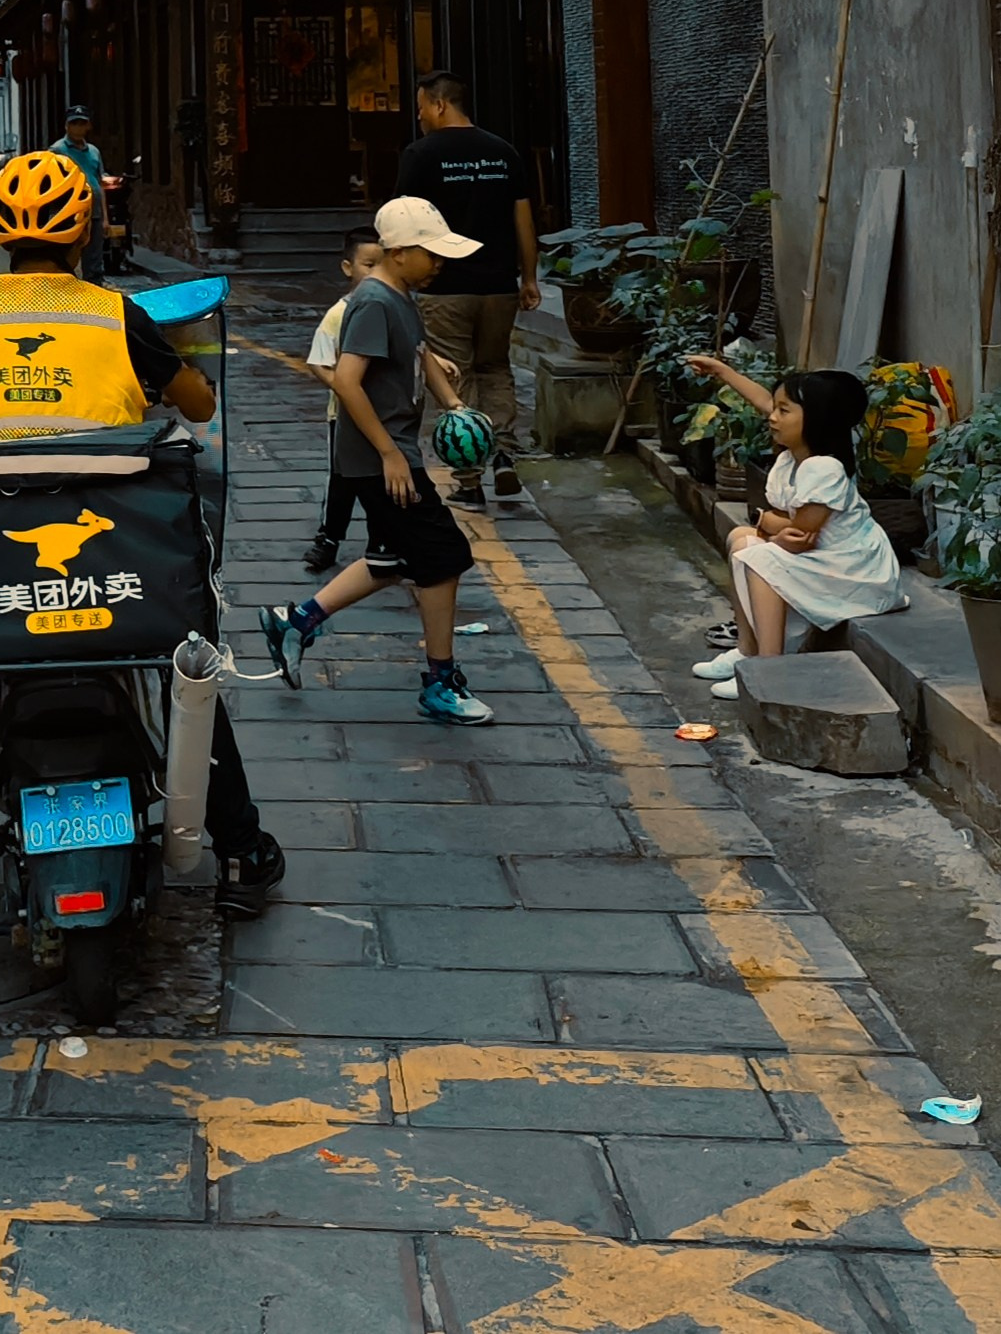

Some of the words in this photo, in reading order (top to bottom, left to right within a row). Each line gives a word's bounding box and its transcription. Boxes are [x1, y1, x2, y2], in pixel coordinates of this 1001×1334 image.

[35, 611, 103, 631] 美团专送
[43, 792, 109, 815] 张家界
[30, 812, 129, 847] 0128500
